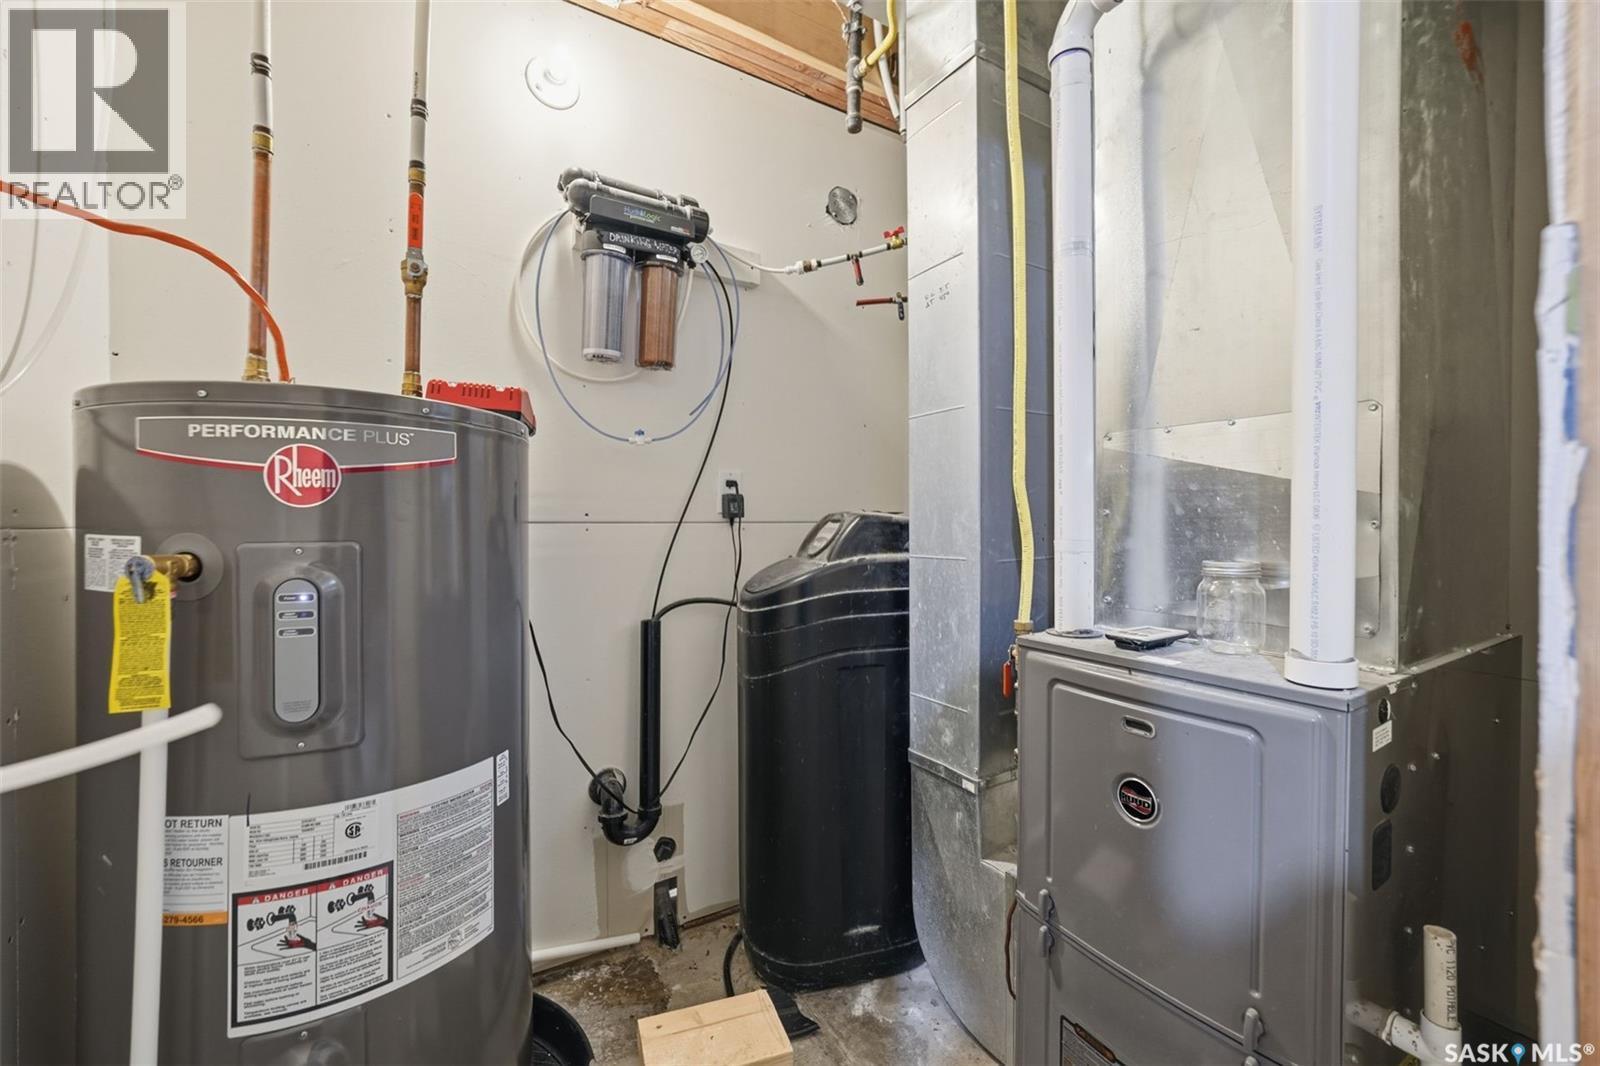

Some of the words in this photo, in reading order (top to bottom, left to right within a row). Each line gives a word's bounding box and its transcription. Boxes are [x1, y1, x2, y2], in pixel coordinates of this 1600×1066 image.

[187, 423, 357, 441] PERFORMANCE
[273, 445, 337, 496] Rheem
[179, 818, 223, 829] RETURN
[170, 857, 223, 868] RETOURNER
[342, 869, 384, 886] DANGER
[264, 888, 309, 902] DANGER
[1446, 960, 1456, 981] 1120
